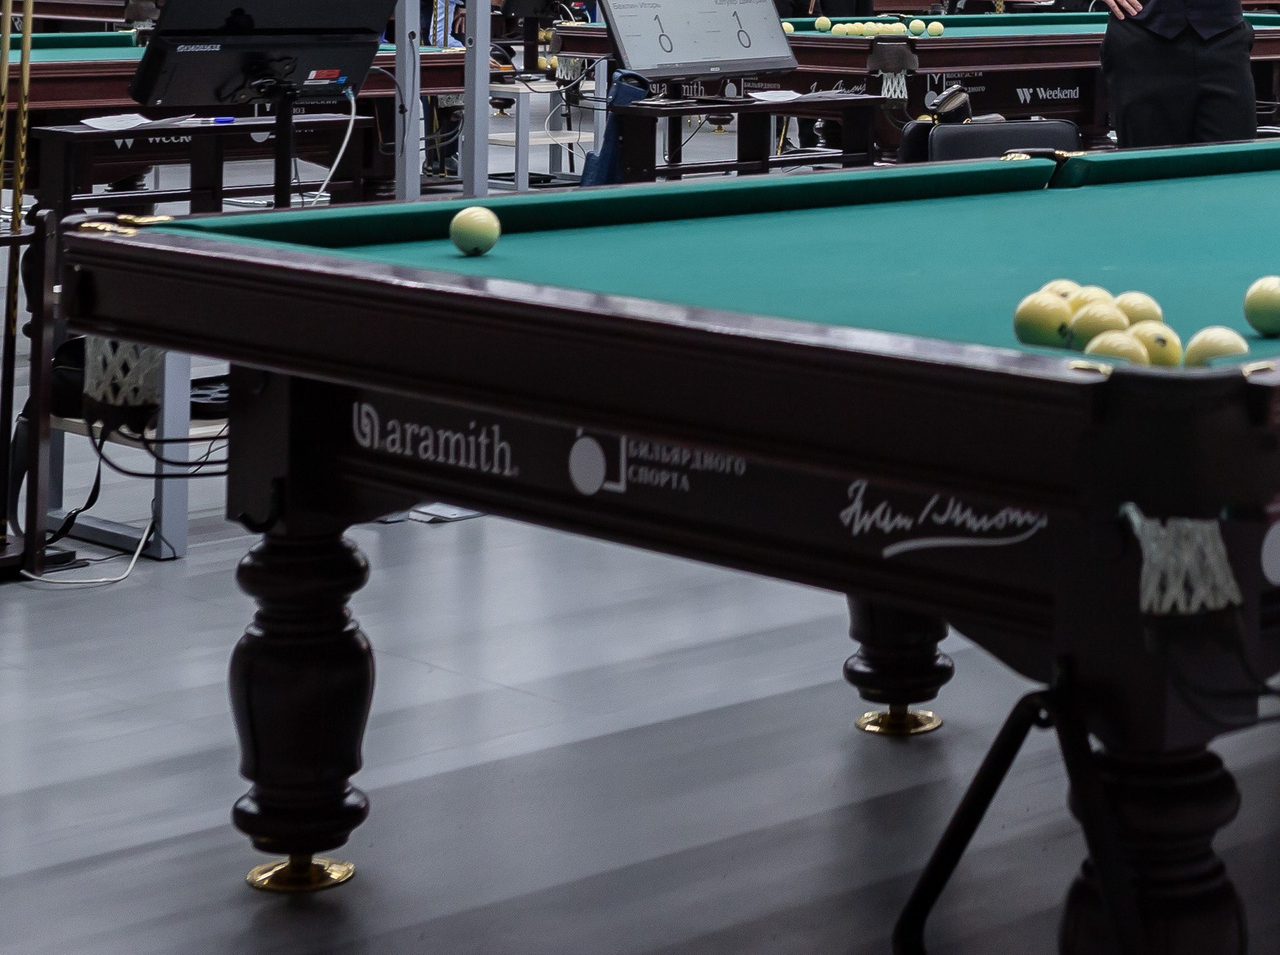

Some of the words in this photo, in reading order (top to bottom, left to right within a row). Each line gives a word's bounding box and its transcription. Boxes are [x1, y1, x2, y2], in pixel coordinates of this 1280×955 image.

[1036, 87, 1079, 99] Weekend
[628, 440, 747, 476] БИЛЬЯРДНОГО
[628, 464, 690, 492] СПОРТА
